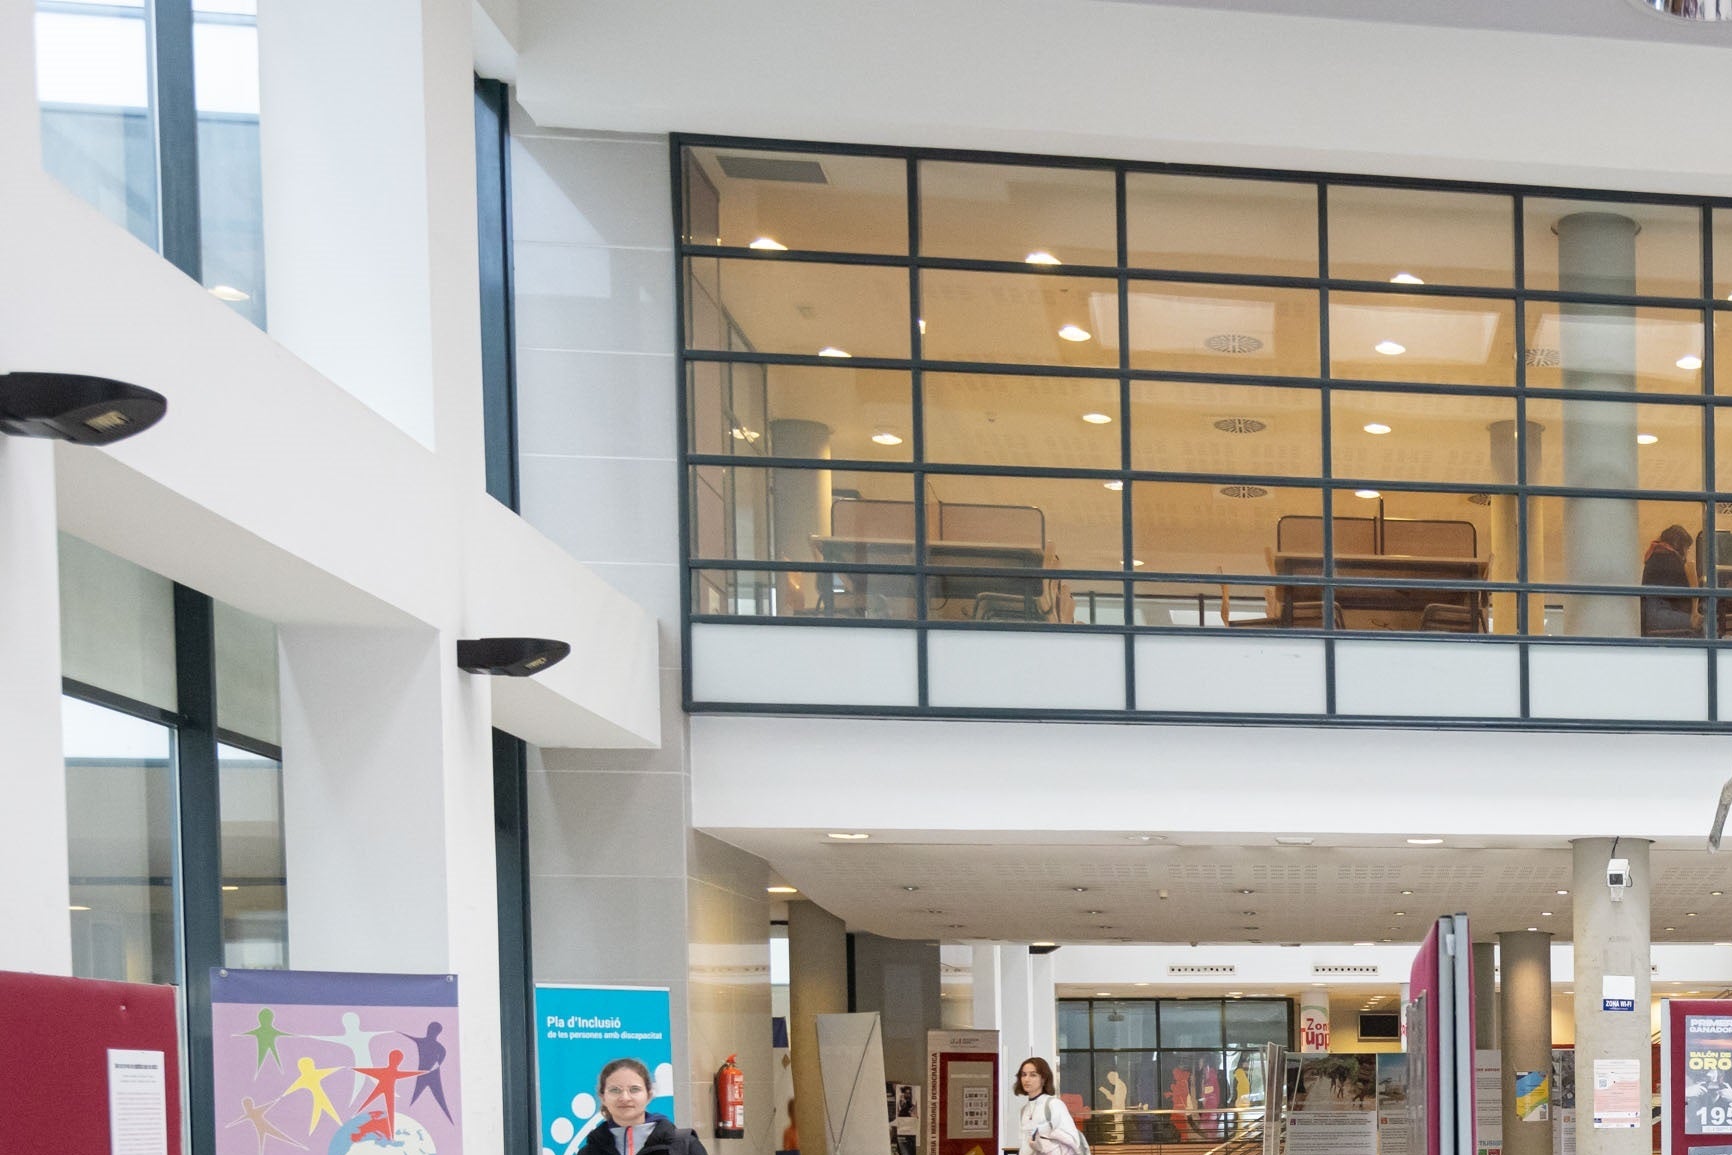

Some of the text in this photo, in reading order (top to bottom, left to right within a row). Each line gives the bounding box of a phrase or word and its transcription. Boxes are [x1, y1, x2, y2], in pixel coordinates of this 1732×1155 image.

[546, 1016, 621, 1029] Pla d'Inclusió
[547, 1031, 557, 1039] de
[558, 1031, 568, 1039] les
[569, 1031, 602, 1040] persones
[620, 1031, 663, 1040] discapacitat
[1689, 1057, 1732, 1070] ORO
